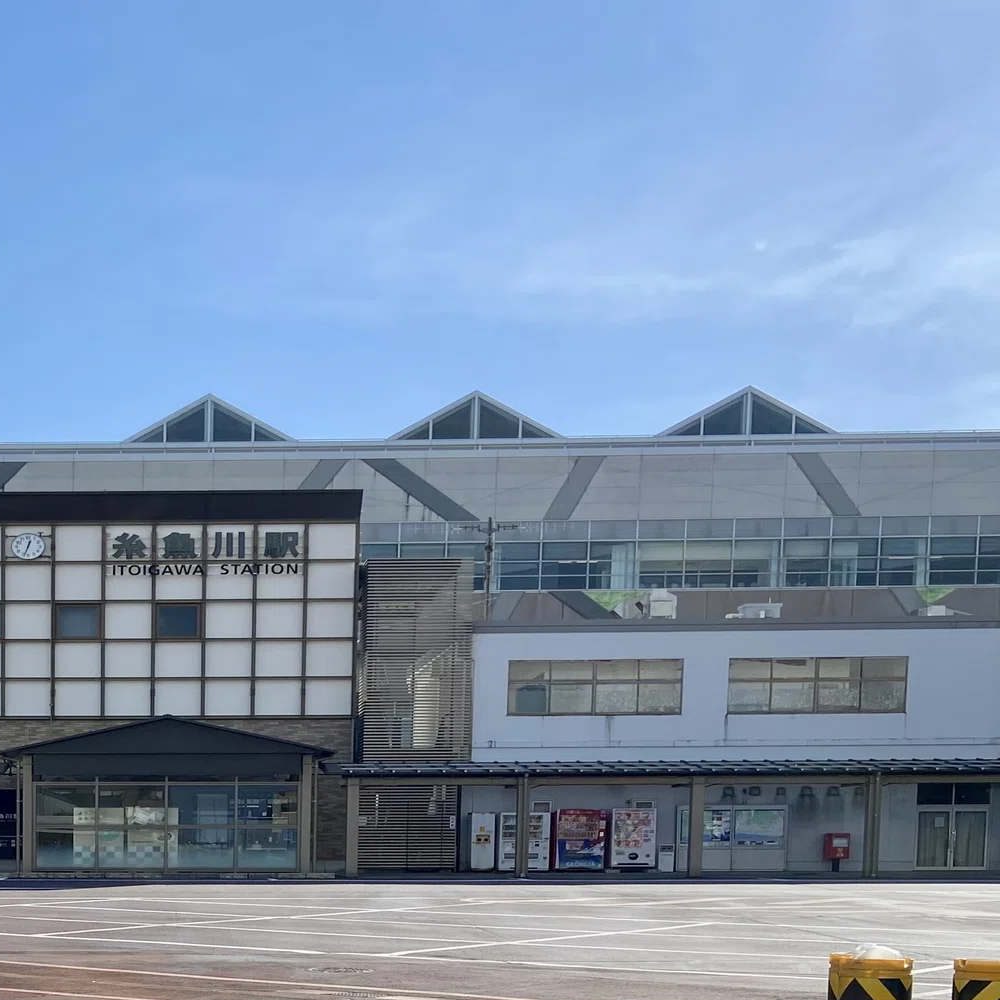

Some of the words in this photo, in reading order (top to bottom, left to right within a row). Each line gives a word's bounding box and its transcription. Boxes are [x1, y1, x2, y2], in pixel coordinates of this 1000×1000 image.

[112, 532, 299, 559] 糸魚川駅
[112, 564, 204, 576] ITOIGAWA
[220, 563, 299, 575] STATION
